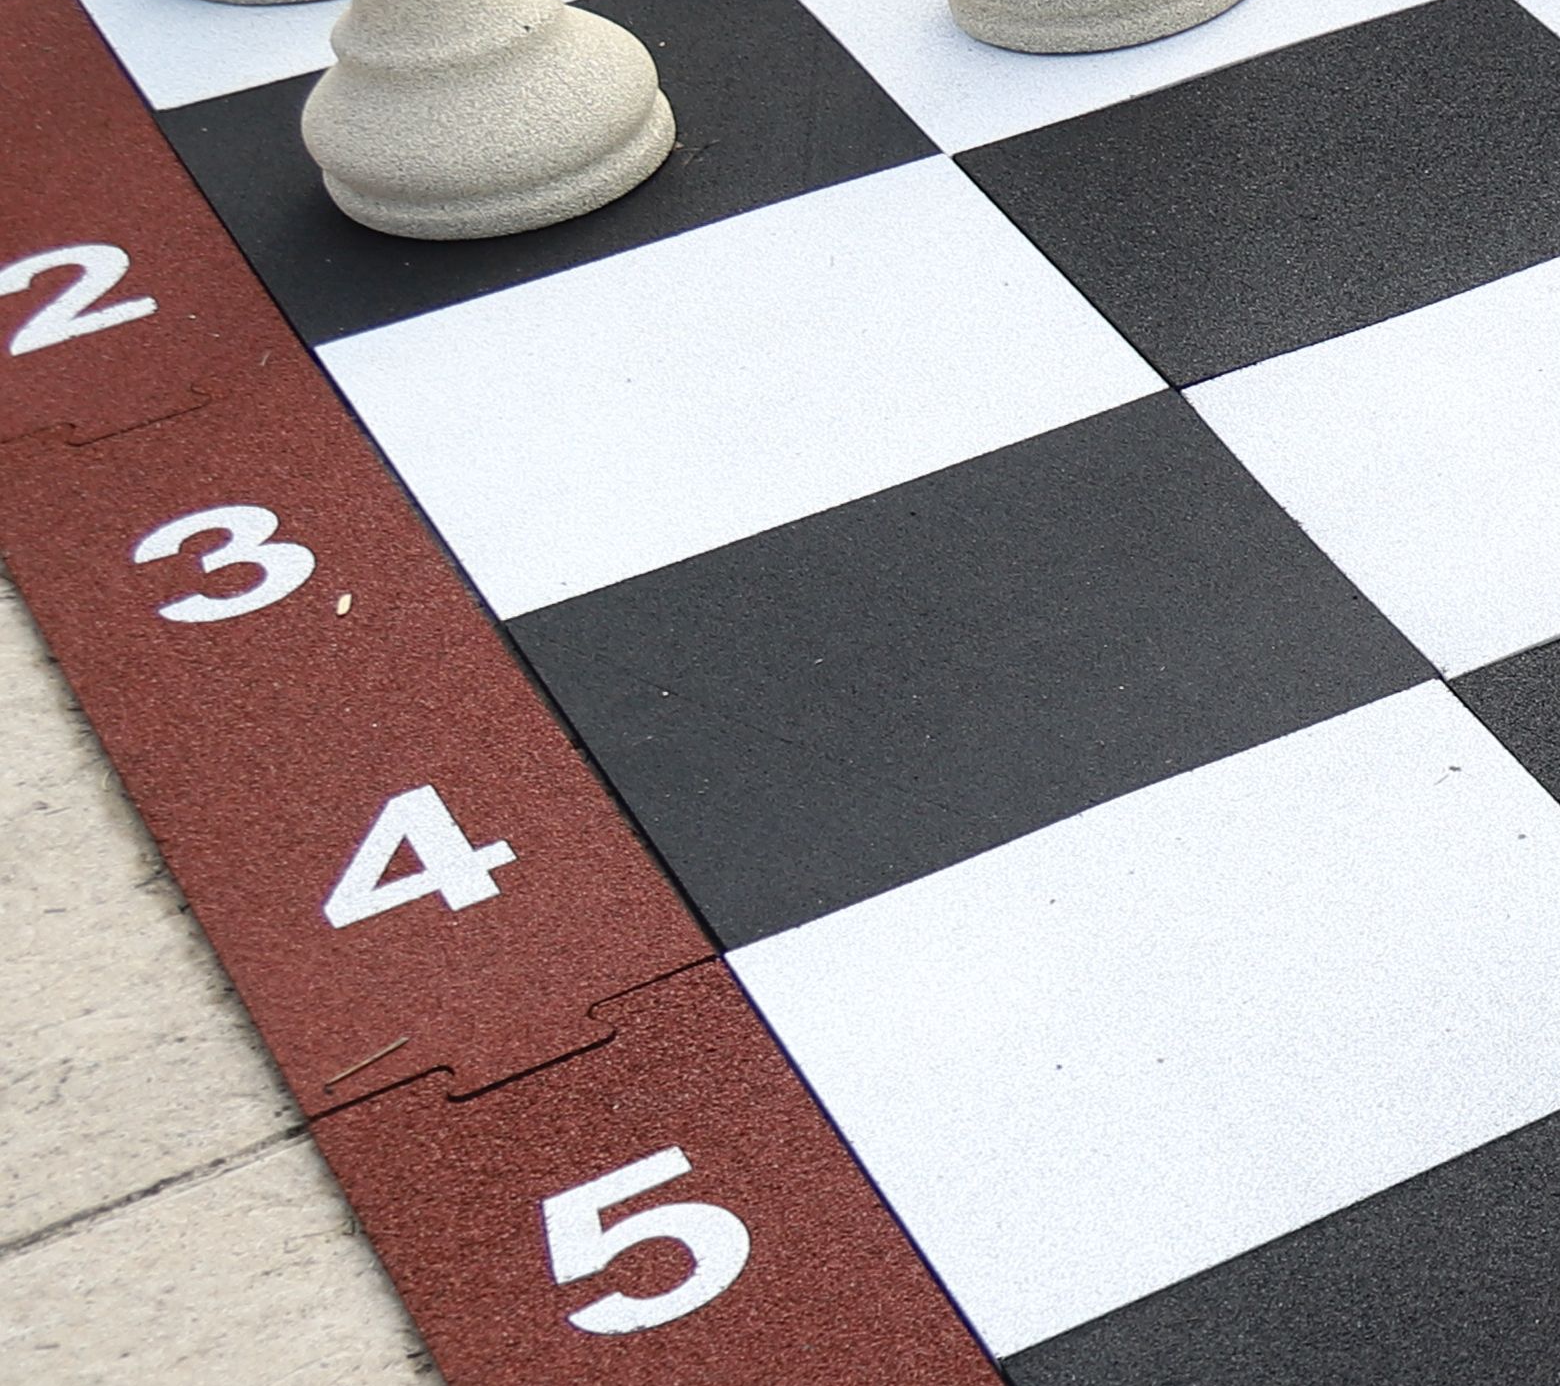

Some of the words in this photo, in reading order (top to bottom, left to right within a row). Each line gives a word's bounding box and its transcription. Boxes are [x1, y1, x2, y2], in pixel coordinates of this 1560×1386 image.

[0, 244, 157, 356] 2
[132, 505, 315, 623] 3
[322, 784, 517, 929] 4
[542, 1146, 750, 1334] 5
